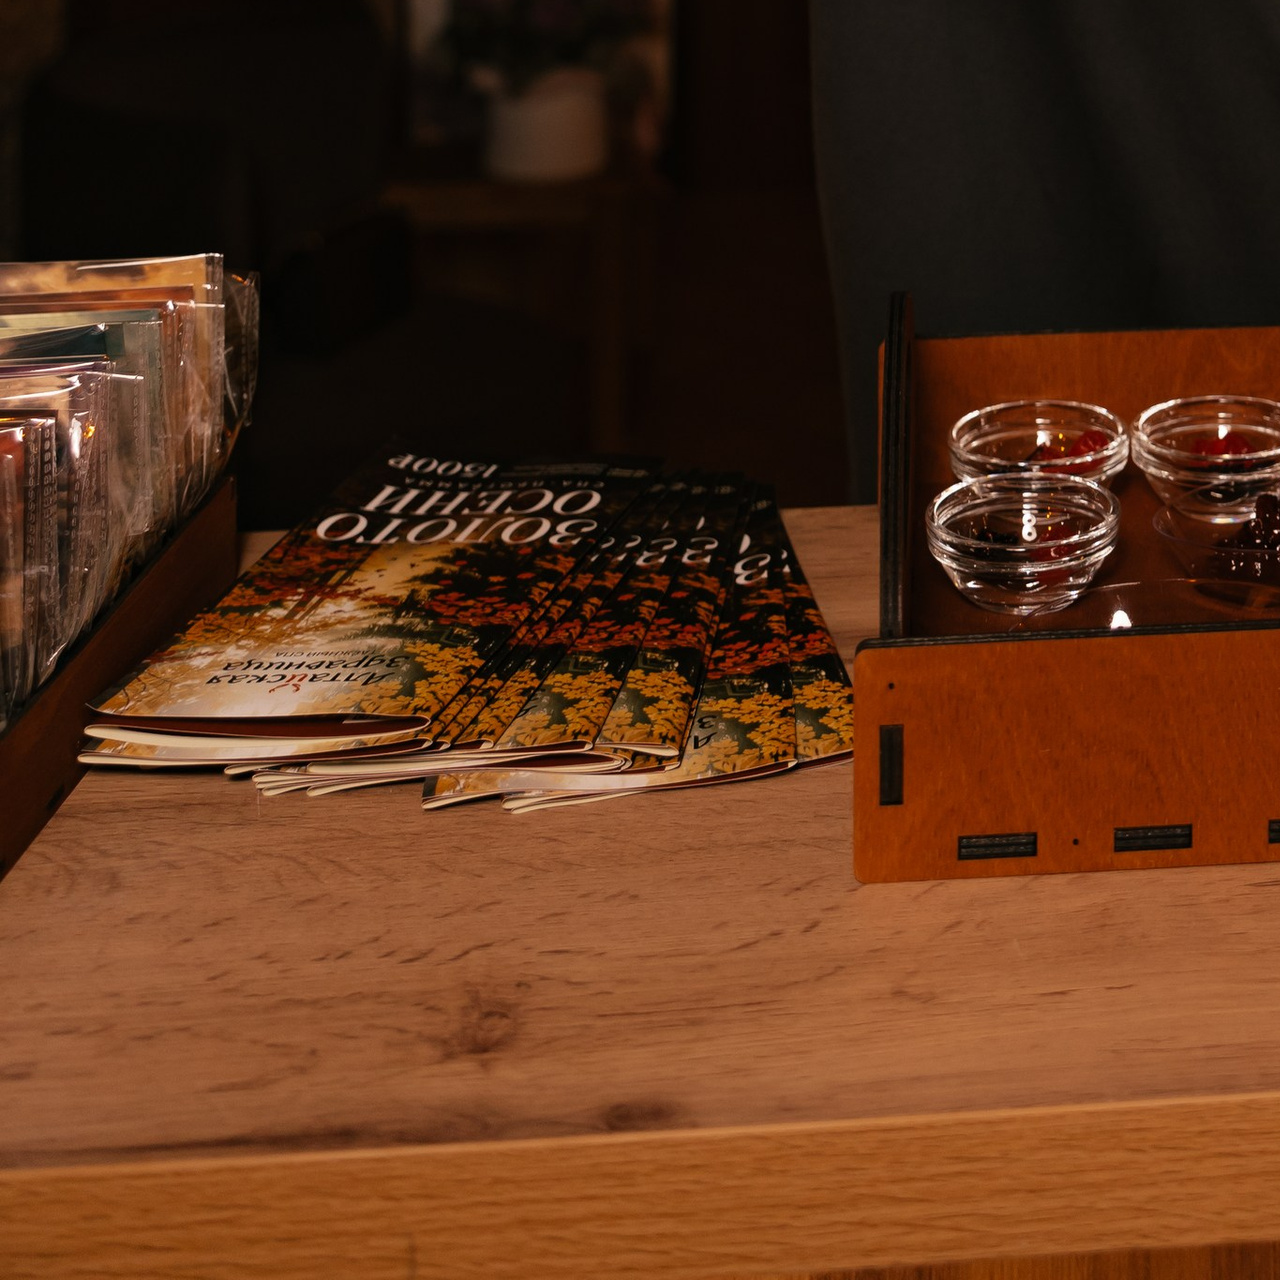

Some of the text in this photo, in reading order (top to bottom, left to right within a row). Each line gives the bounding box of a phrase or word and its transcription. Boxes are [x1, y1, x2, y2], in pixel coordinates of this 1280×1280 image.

[360, 484, 602, 517] ОСЕНИ
[315, 512, 599, 546] ЗОЛОТО
[222, 654, 411, 671] Здравница
[205, 671, 395, 691] Алтайская
